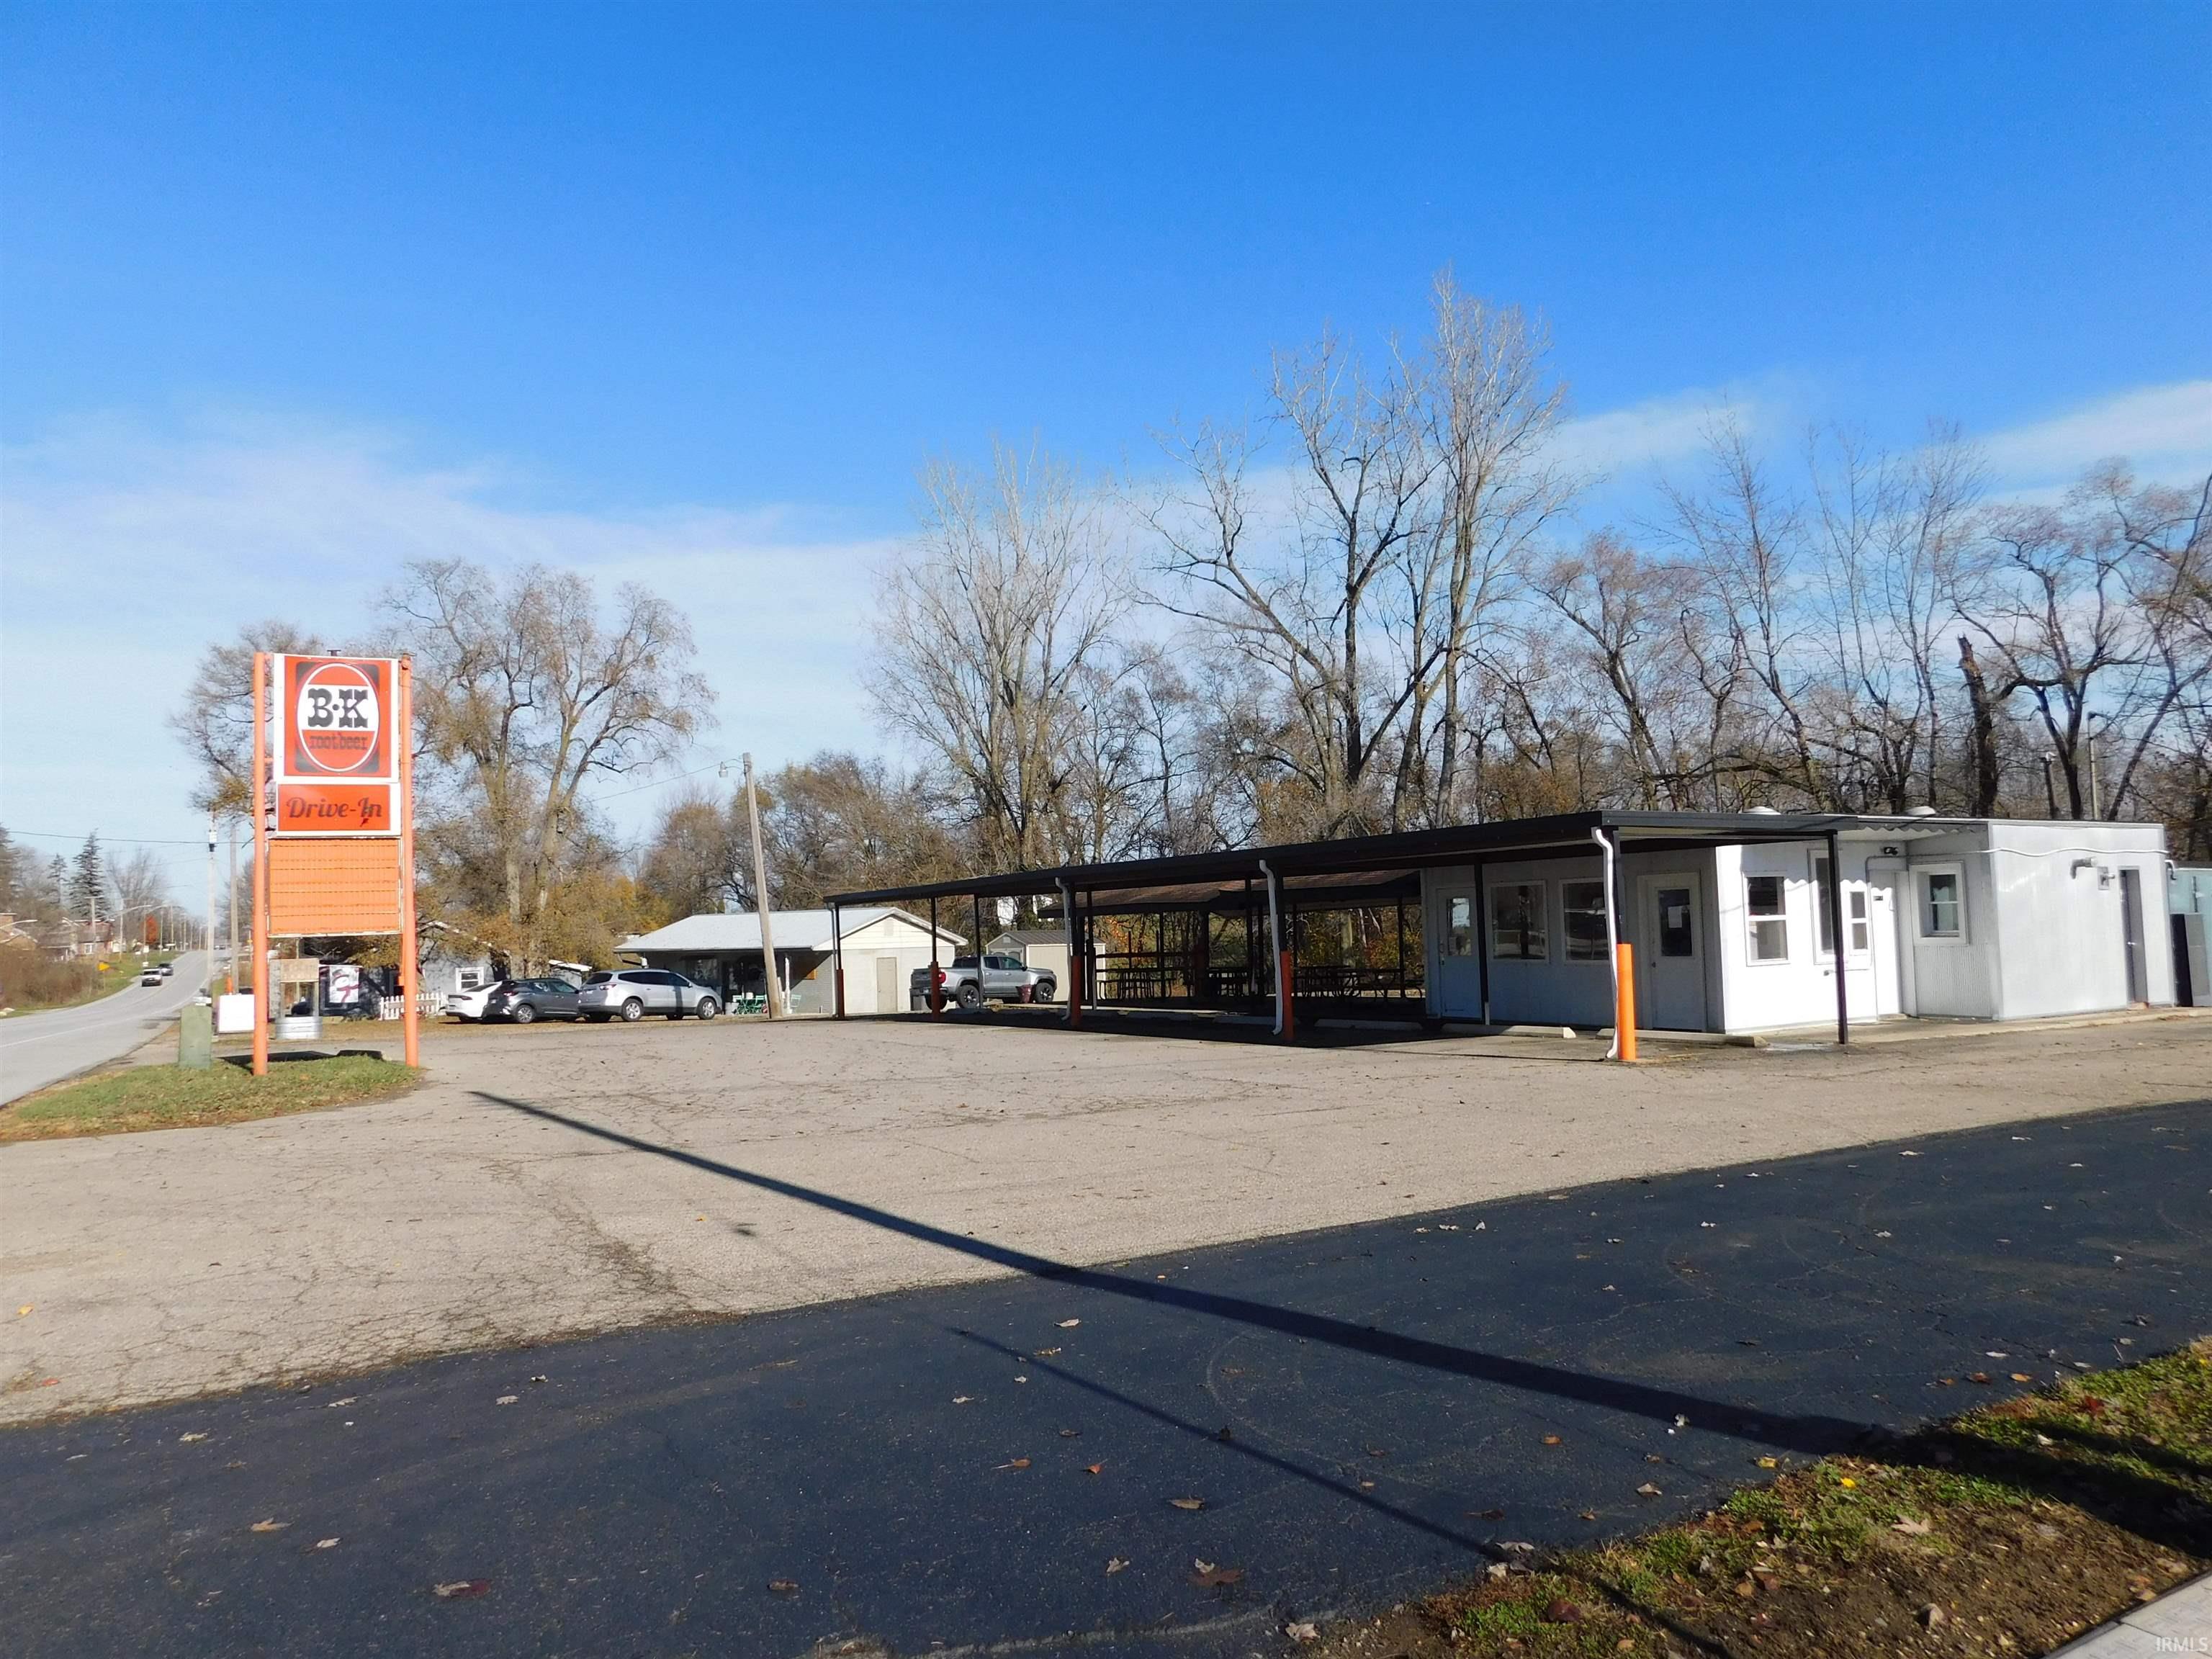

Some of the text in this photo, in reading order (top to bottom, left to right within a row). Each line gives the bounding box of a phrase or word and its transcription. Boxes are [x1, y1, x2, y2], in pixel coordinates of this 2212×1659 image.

[310, 732, 368, 750] root beer
[287, 796, 382, 818] Drive-In
